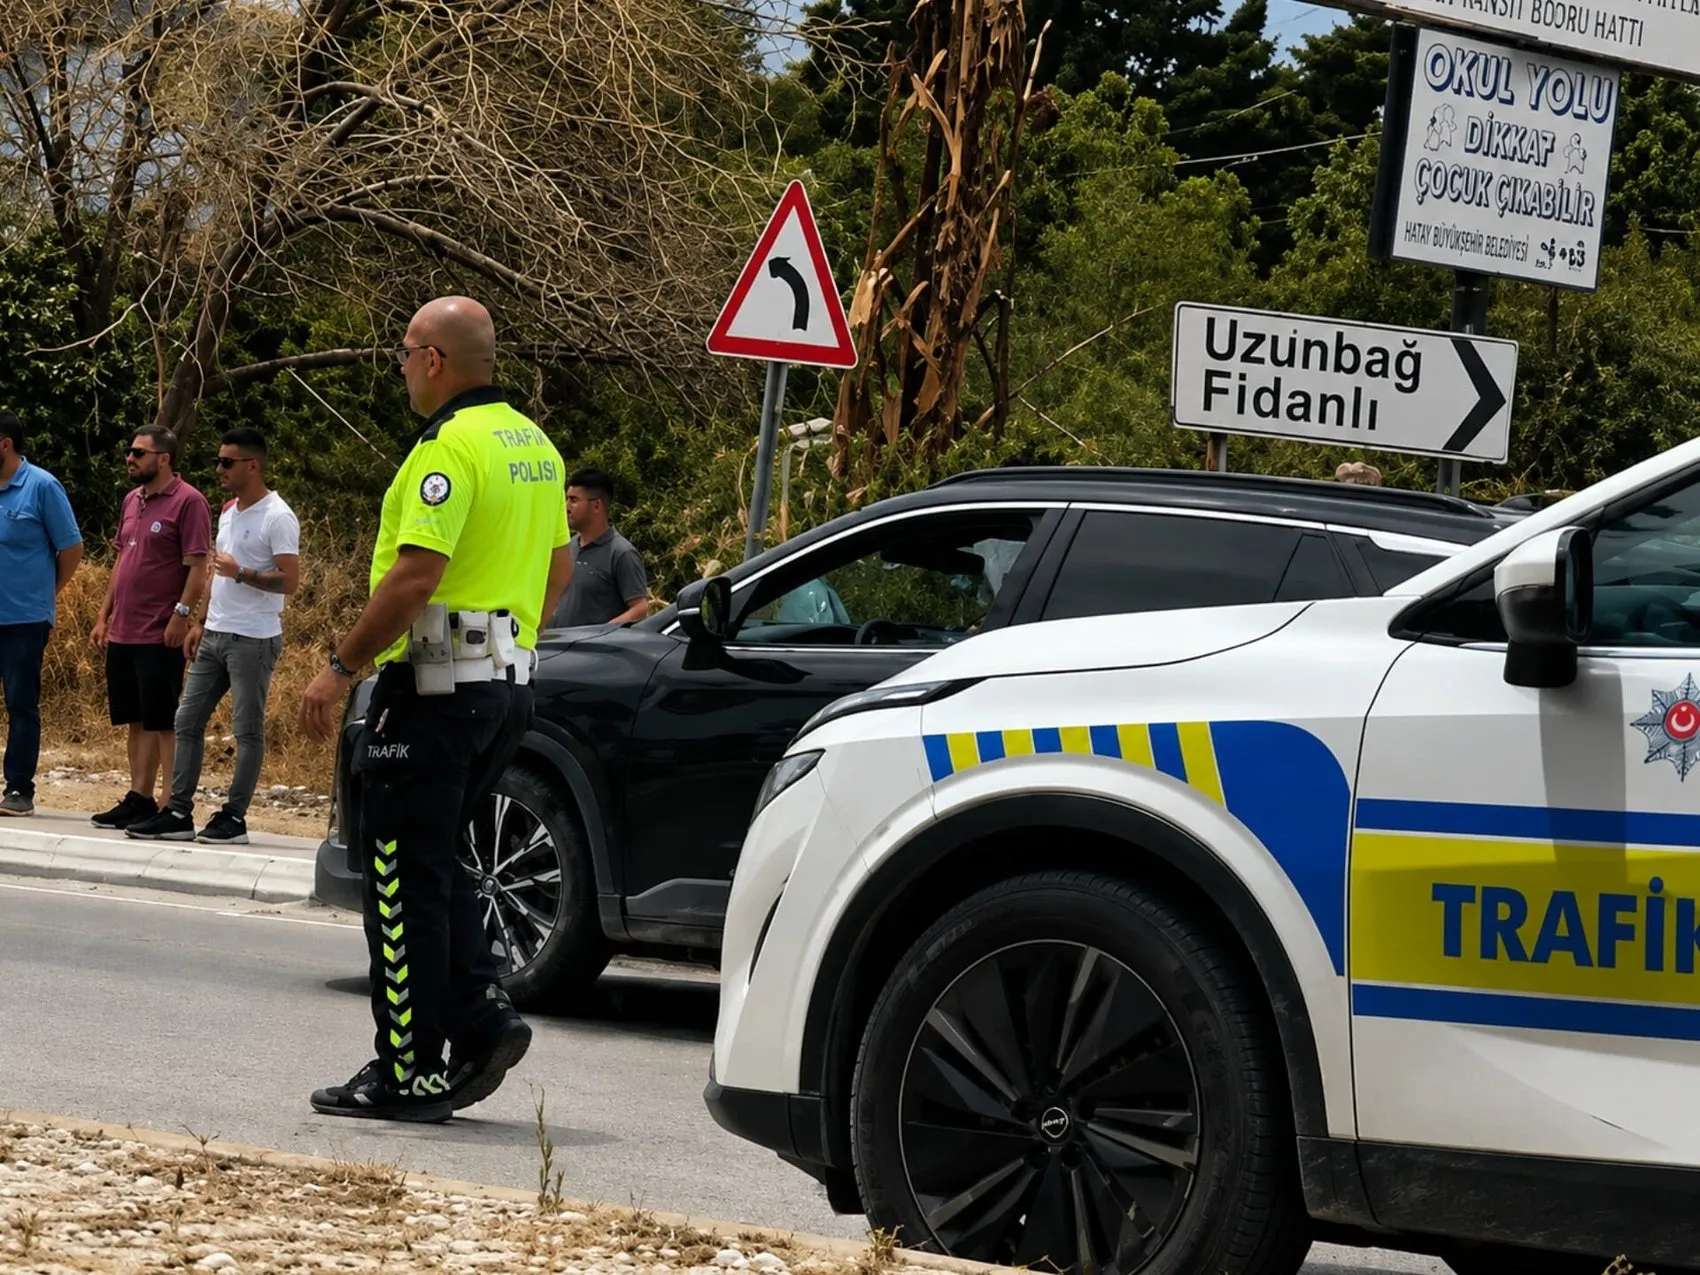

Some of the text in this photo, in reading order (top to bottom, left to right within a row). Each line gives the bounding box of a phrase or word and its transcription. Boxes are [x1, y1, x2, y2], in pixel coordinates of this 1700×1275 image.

[1594, 10, 1644, 47] HATTI
[1424, 43, 1613, 124] OKUL YOLU
[1415, 157, 1596, 228] ÇOCUK ÇIKABİLİR
[1403, 220, 1432, 244] HATAY
[1206, 316, 1423, 394] Uzunbağ
[1202, 368, 1379, 431] Fidanlı
